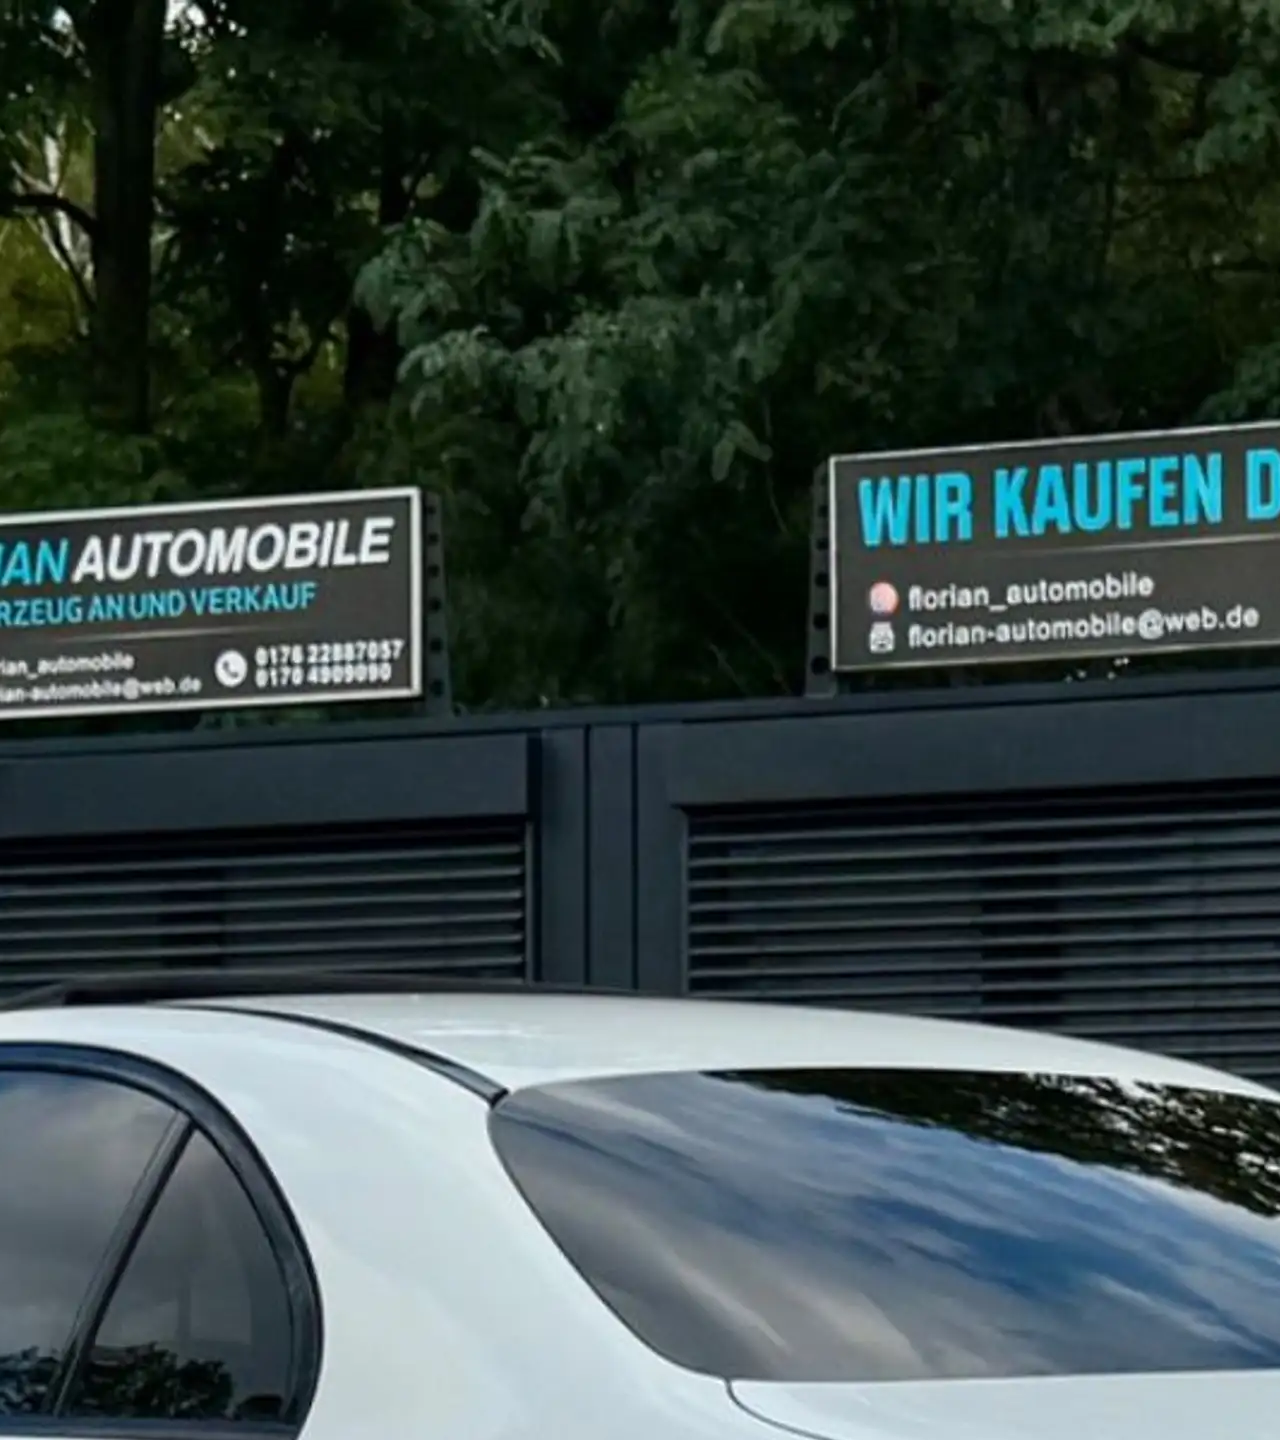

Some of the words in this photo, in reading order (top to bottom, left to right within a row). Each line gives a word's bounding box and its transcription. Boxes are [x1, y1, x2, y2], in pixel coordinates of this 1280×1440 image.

[859, 471, 973, 546] WIR
[994, 452, 1223, 538] KAUFEN
[71, 516, 395, 584] AUTOMOBILE
[87, 594, 124, 621] AN
[128, 590, 186, 619] UND
[191, 581, 318, 616] VERKAUF
[907, 571, 1155, 612] florian_automobile
[907, 604, 1260, 649] florian-automobile@web.de
